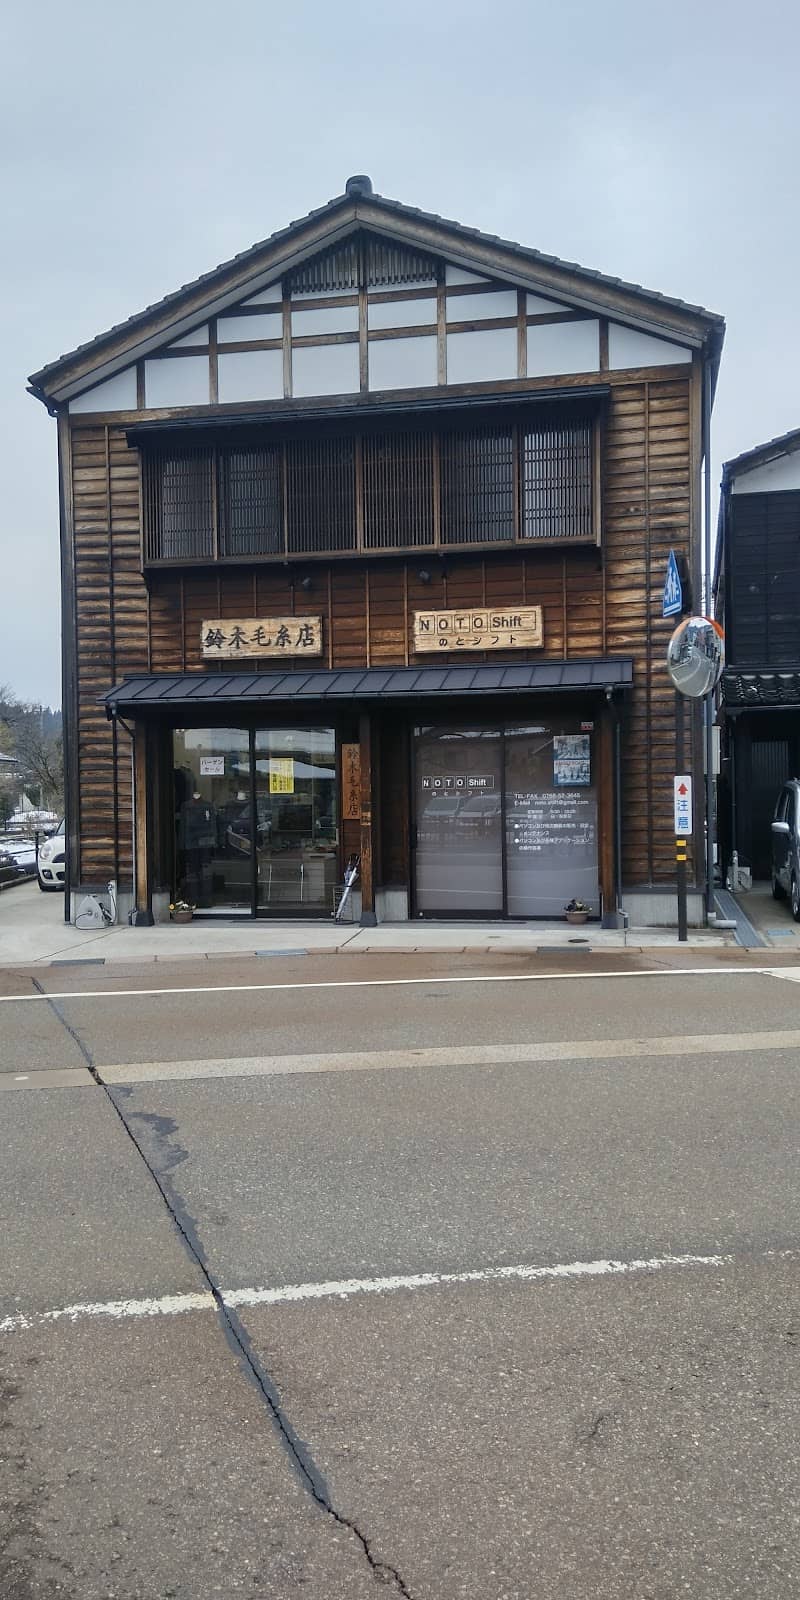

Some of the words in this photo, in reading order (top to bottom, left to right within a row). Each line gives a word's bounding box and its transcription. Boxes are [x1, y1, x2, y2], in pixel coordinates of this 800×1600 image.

[492, 615, 522, 629] Shift
[202, 624, 315, 649] 鈴木毛糸店
[438, 635, 517, 647] のとシフト
[346, 747, 360, 816] 鈴木毛糸店
[468, 778, 487, 786] Shift
[677, 799, 689, 829] 注意
